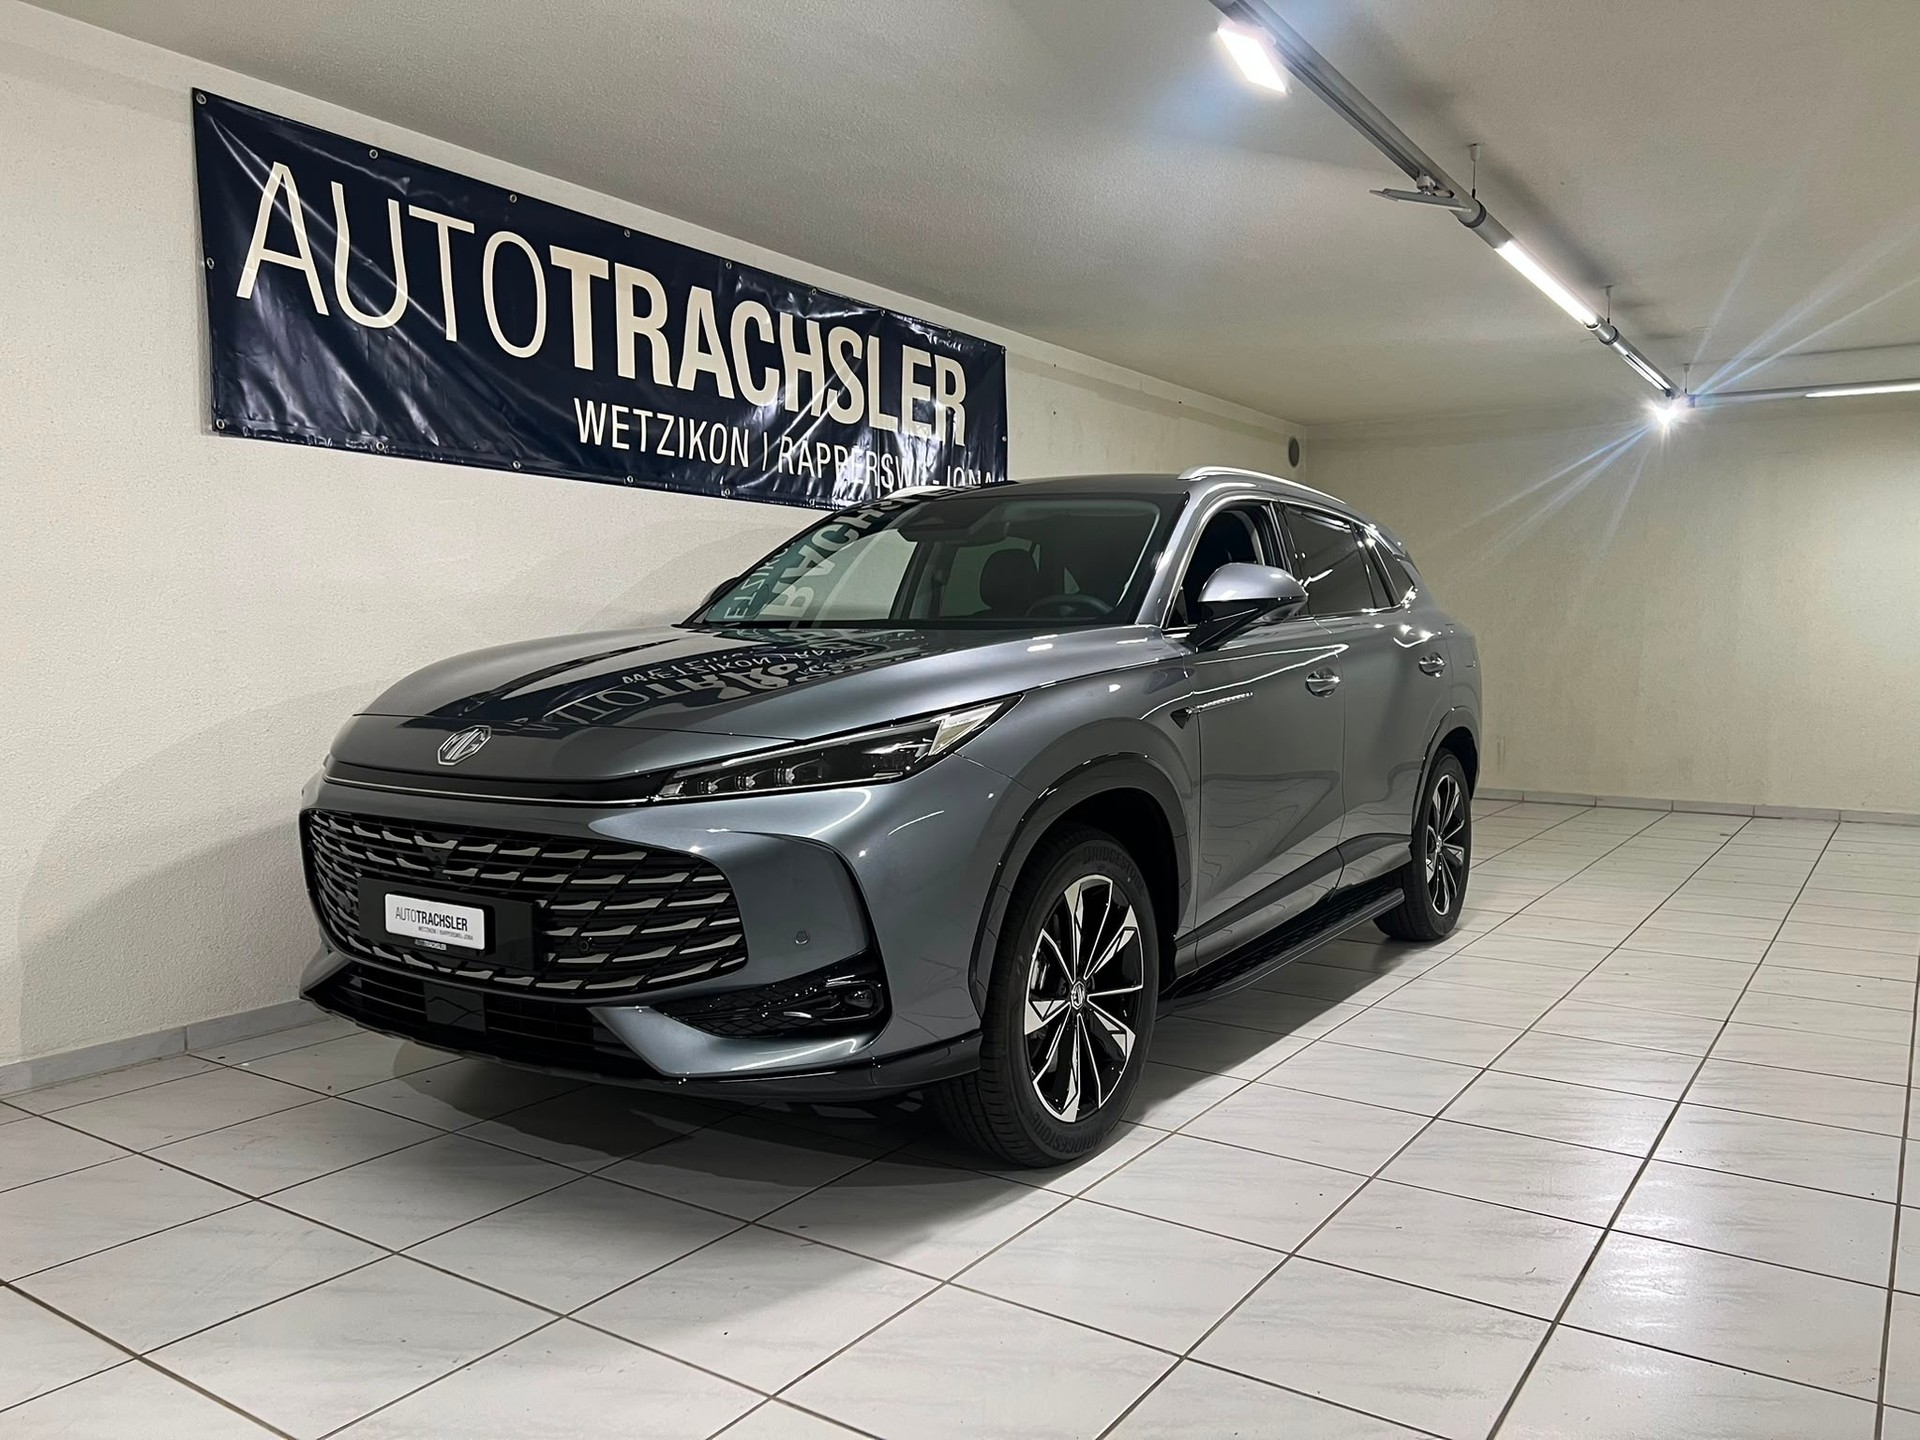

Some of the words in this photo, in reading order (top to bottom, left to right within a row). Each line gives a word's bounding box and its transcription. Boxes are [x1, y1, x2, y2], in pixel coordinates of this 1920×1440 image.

[236, 161, 967, 447] AUTOTRACHSLER
[573, 397, 749, 468] WETZIKON
[395, 907, 468, 931] AUTOTRACHSLER
